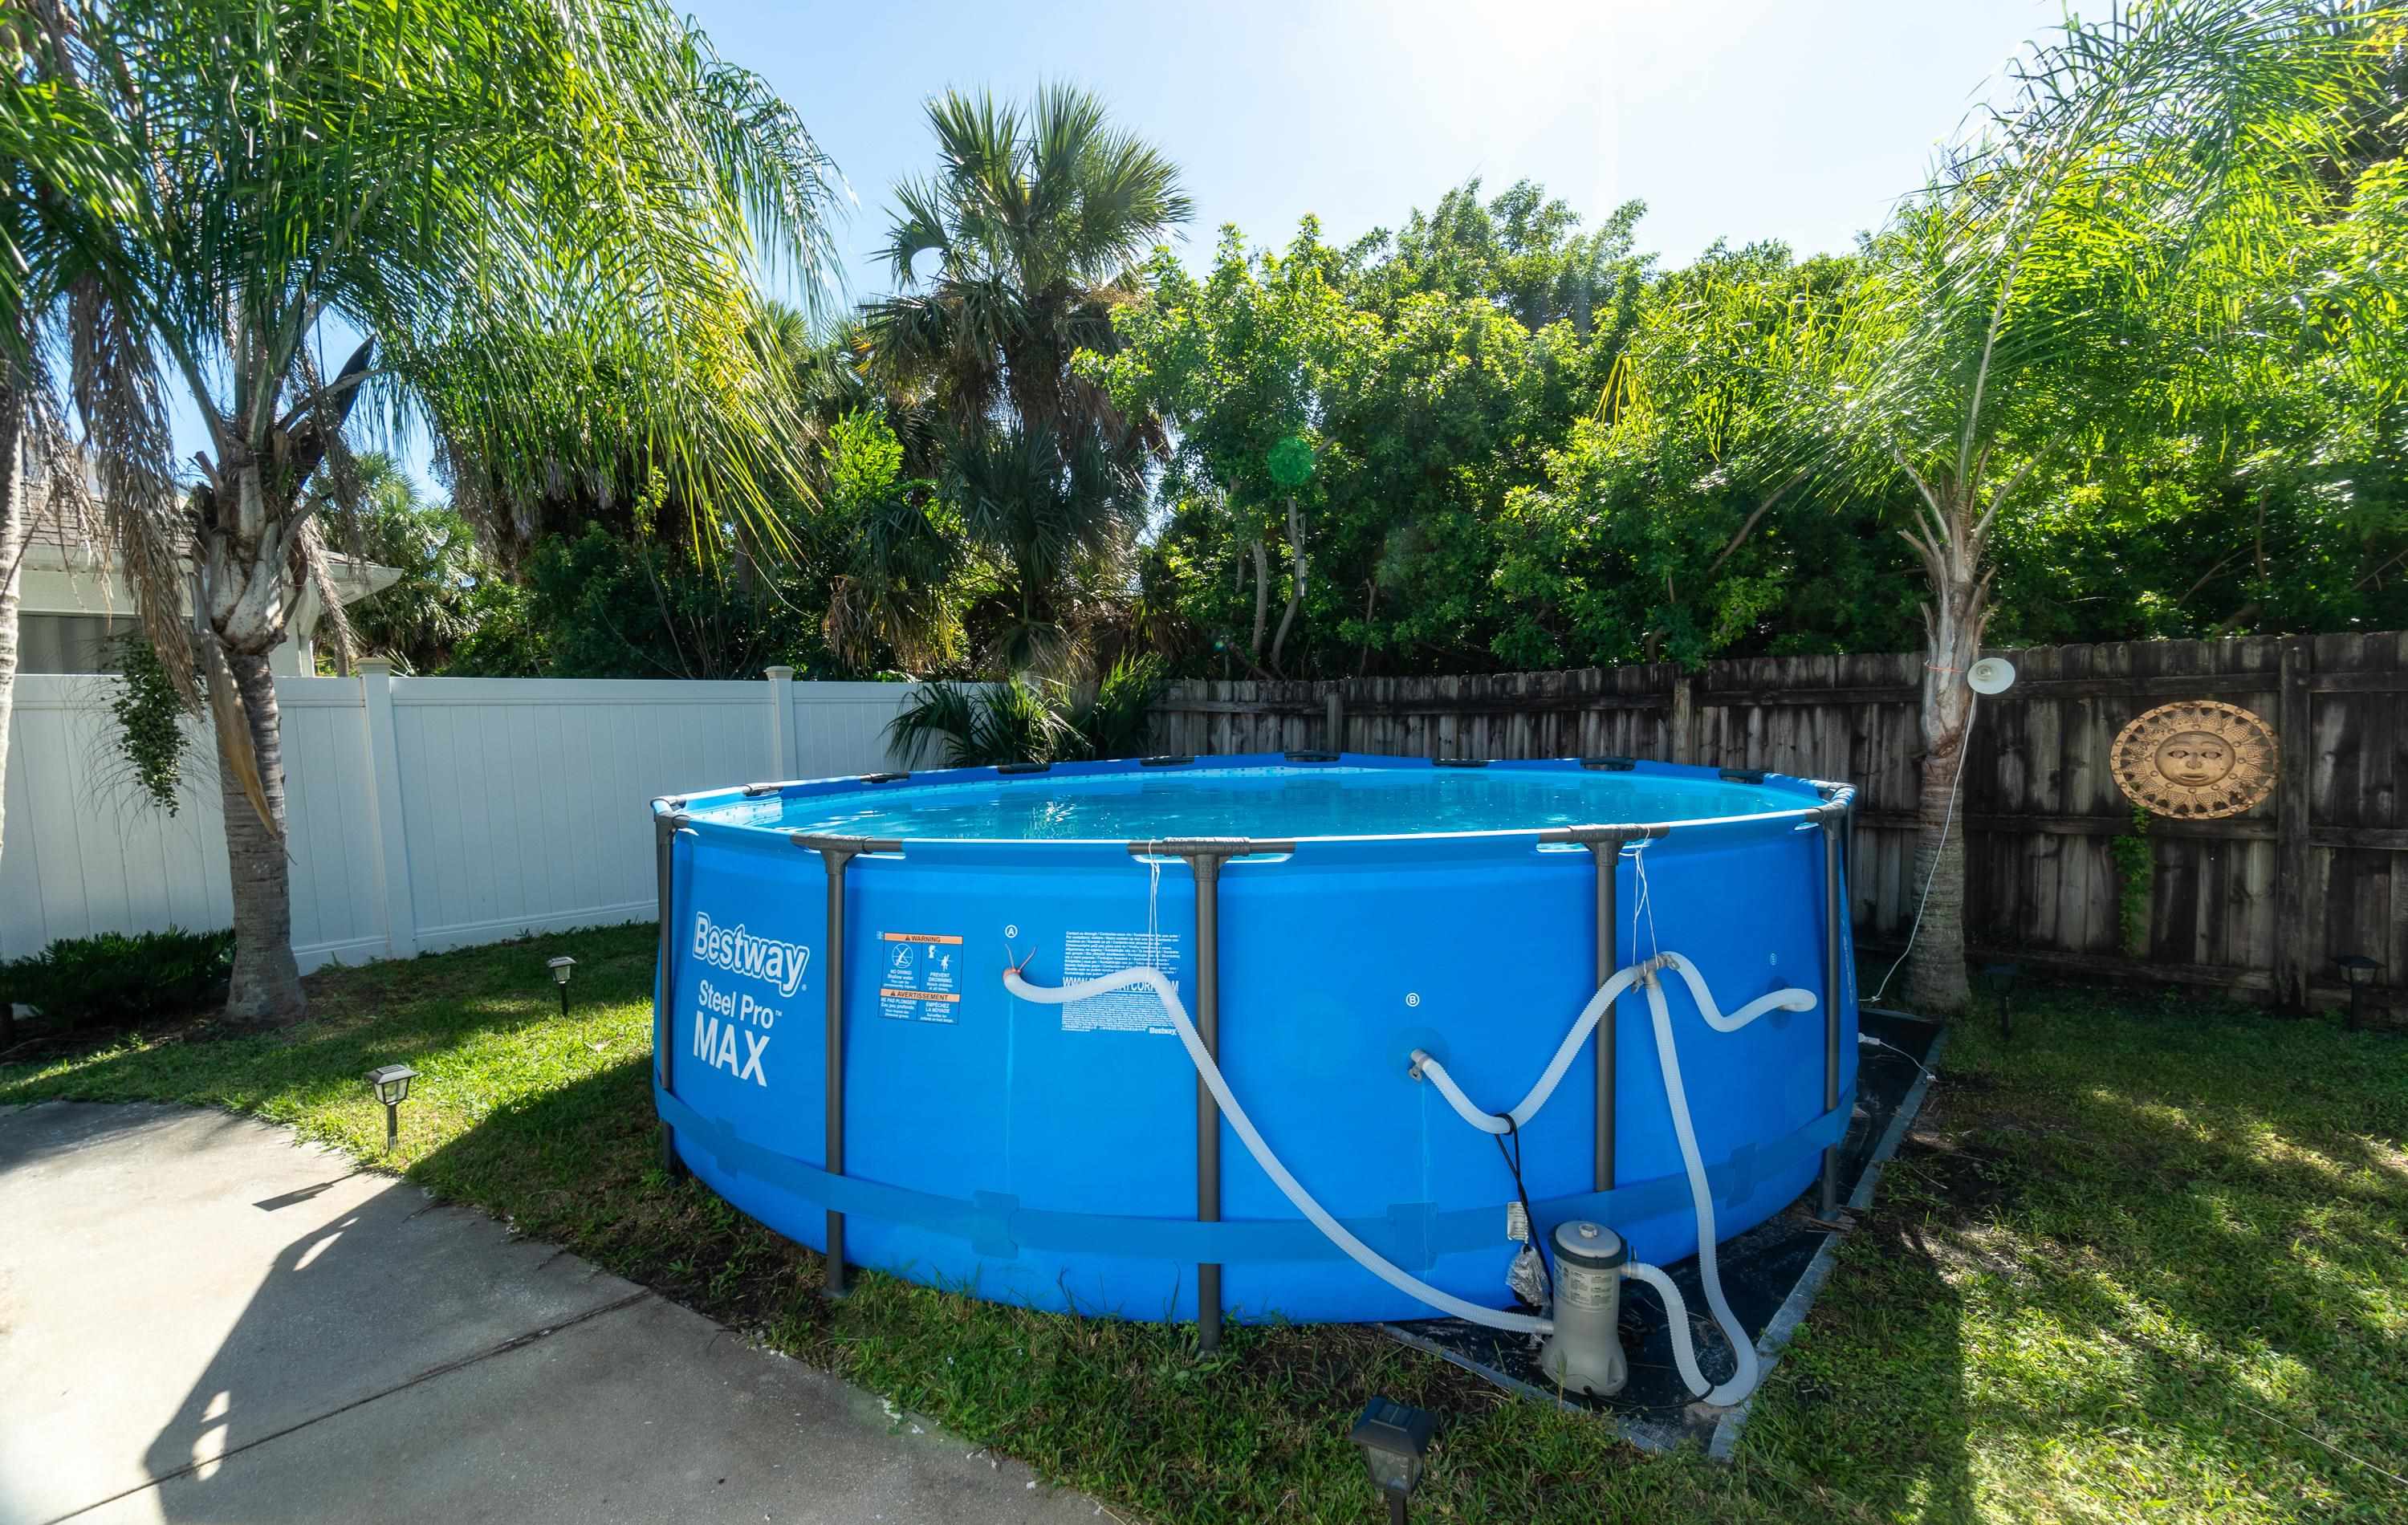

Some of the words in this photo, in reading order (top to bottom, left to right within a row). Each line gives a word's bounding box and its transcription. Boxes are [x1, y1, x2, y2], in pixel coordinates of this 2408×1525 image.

[693, 911, 810, 998] Bestway
[911, 935, 942, 943] WARNING
[698, 979, 737, 1018] Steel
[897, 991, 949, 1000] AVERTISSEMENT
[693, 1011, 771, 1088] MAX
